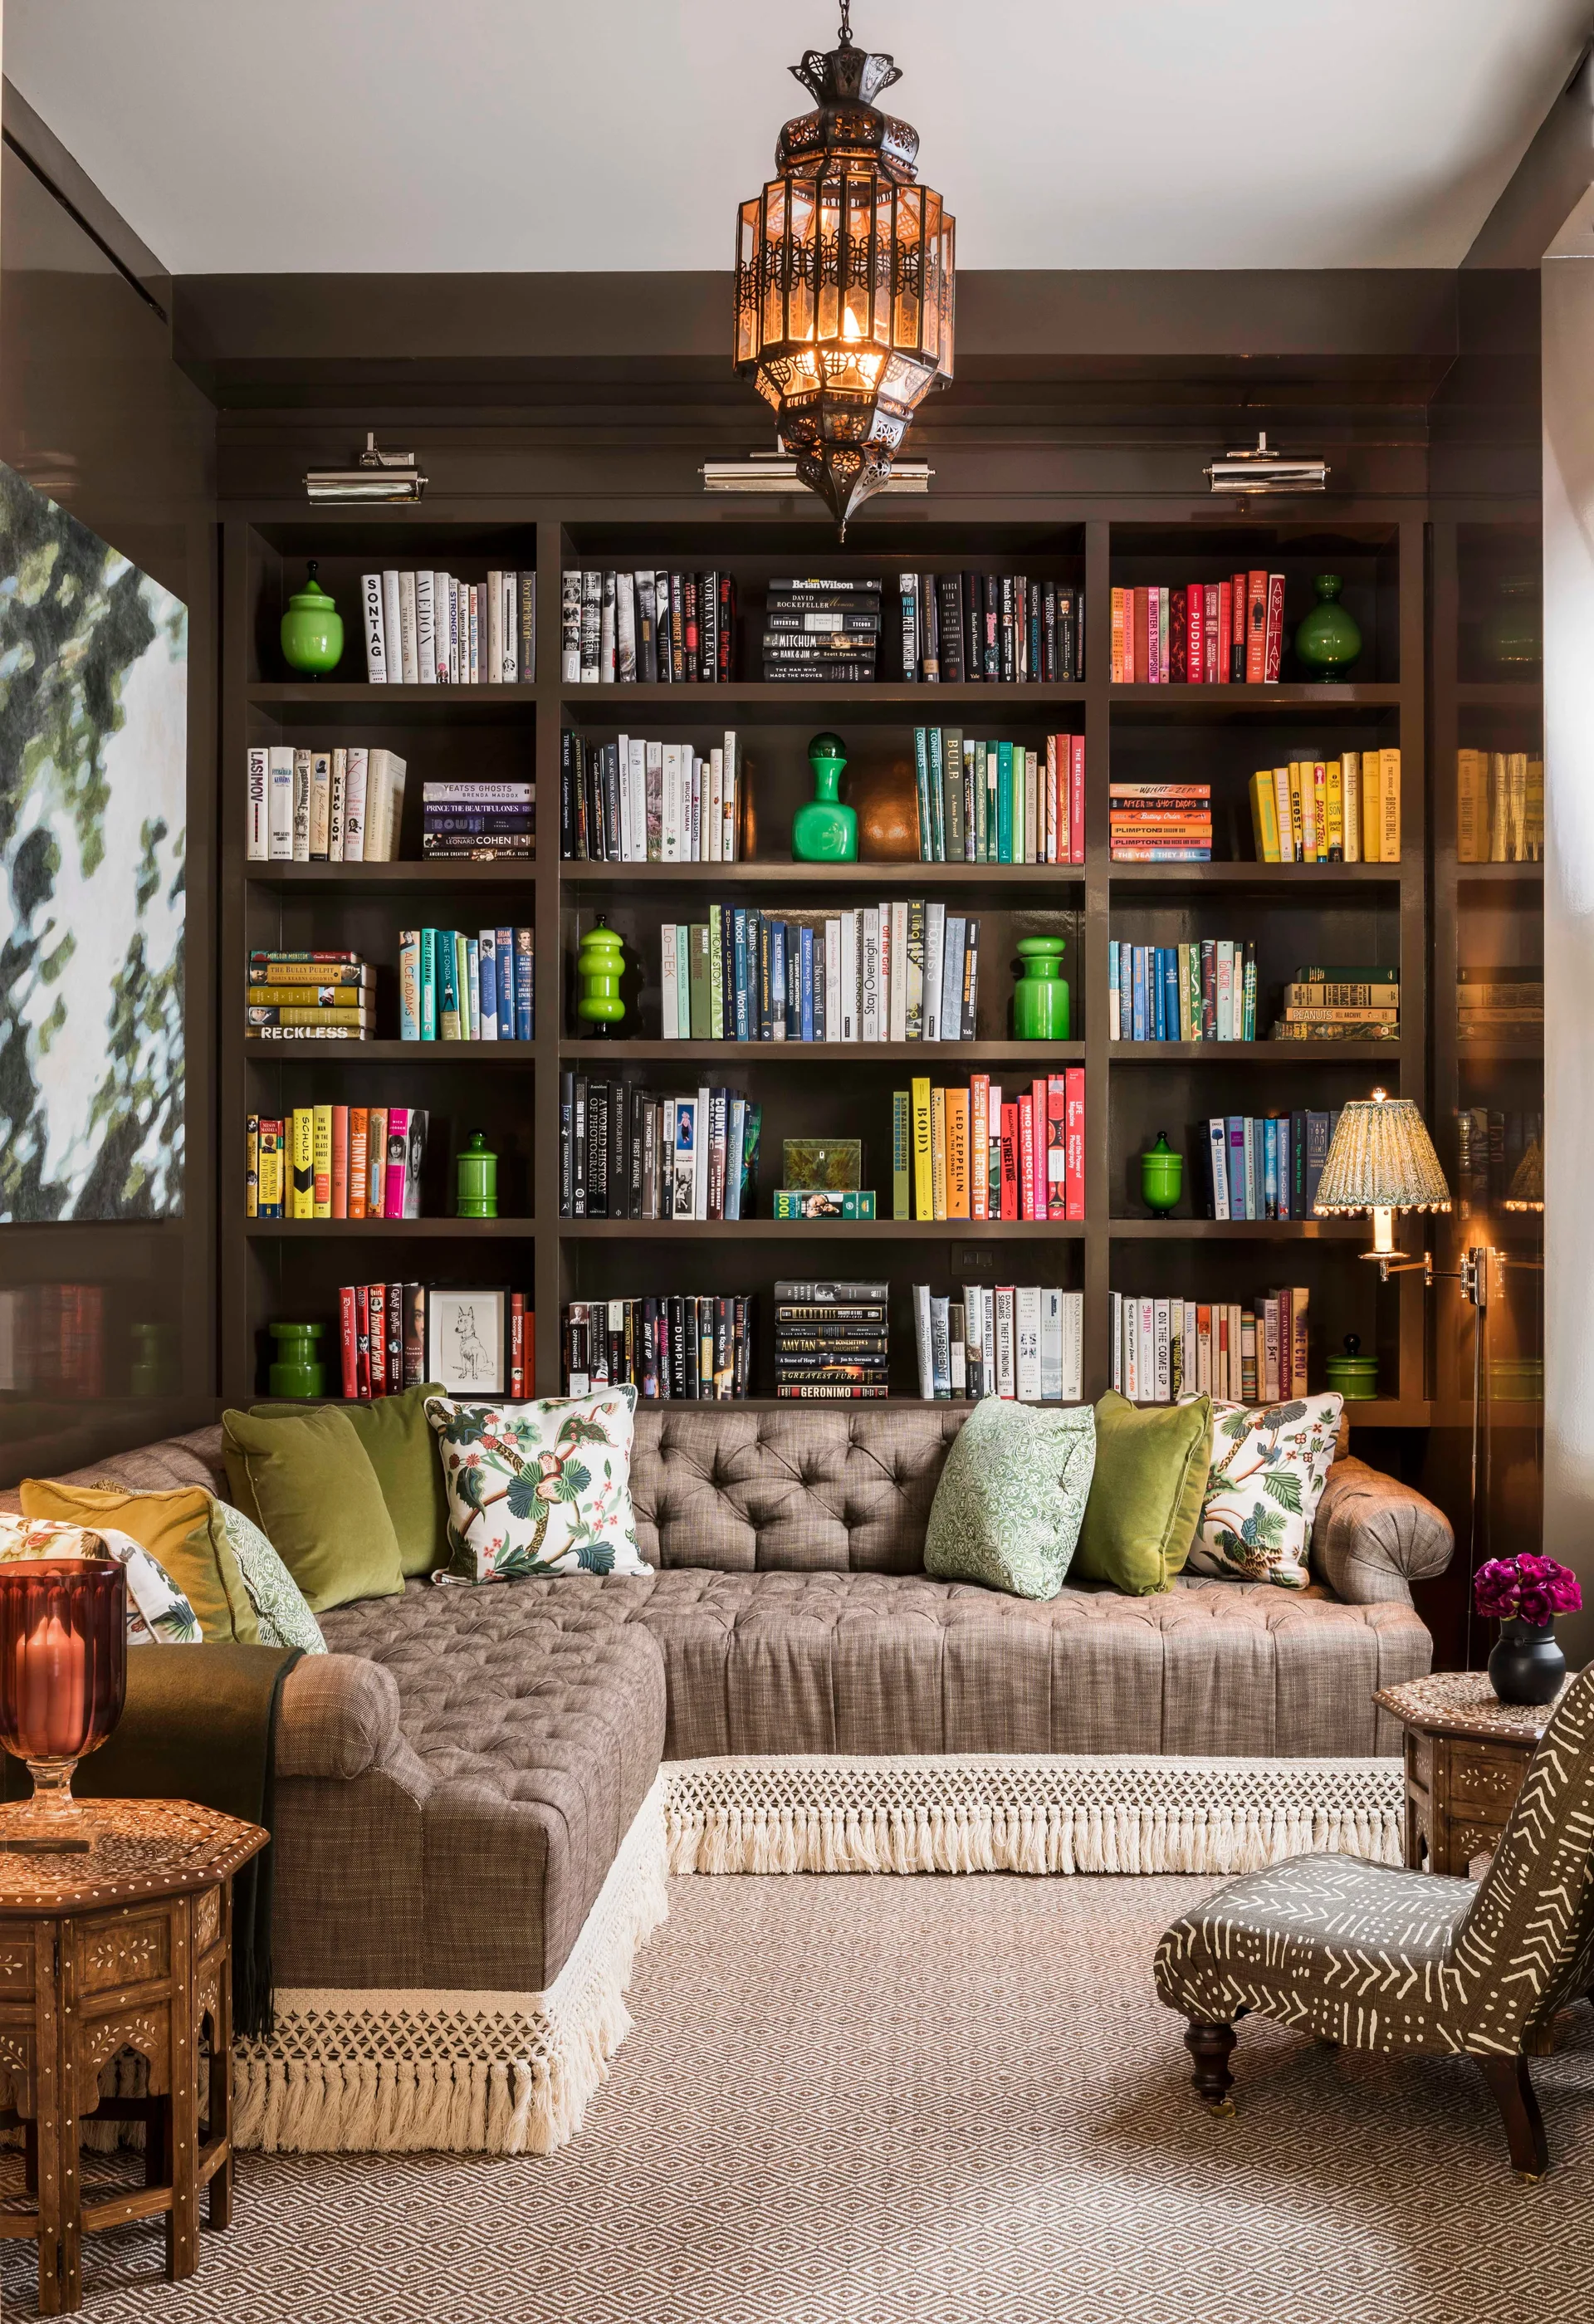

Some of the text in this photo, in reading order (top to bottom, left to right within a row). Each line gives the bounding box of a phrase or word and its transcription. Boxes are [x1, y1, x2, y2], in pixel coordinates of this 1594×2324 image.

[587, 576, 595, 600] BRUCE
[902, 597, 914, 606] WHO
[368, 580, 382, 657] SONTAG
[704, 576, 714, 666] NORMAN LEAR
[779, 635, 817, 648] MITCHUM
[902, 617, 914, 669] PETE TOWNSHEND
[1150, 638, 1158, 677] THOMPSON
[917, 732, 925, 767] CONIFERS
[931, 732, 939, 768] CONIFERS
[947, 740, 959, 779] BULB
[1293, 792, 1301, 829] GHOST
[1329, 805, 1341, 815] SON
[748, 918, 757, 951] Cabins
[712, 932, 721, 989] HOME STORY
[736, 916, 746, 1020] Wood Works
[864, 937, 878, 1015] Stay Overnight
[404, 952, 414, 1016] ALICE ADAMS
[814, 965, 823, 1014] bloom wild
[261, 1027, 348, 1040] RECKLESS
[1293, 1010, 1332, 1020] PEANUTS
[562, 1104, 571, 1122] Jazz
[599, 1108, 607, 1146] WORLD
[714, 1098, 726, 1150] COUNTRY
[917, 1108, 928, 1153] BODY
[351, 1133, 367, 1197] FUNNY MAN
[589, 1098, 598, 1195] OF PHOTOGRAPHY
[727, 1134, 736, 1185] PHOTOGRAPHS
[269, 1161, 277, 1196] LONG WALK
[598, 1148, 606, 1194] HISTORY
[1158, 1312, 1166, 1324] ON
[1158, 1327, 1166, 1343] THE
[782, 1340, 816, 1351] AMY TAN
[936, 1319, 947, 1380] DIVERGENT
[1295, 1348, 1305, 1378] CROW
[801, 1387, 851, 1397] GERONIMO
[1159, 1373, 1166, 1385] UP
